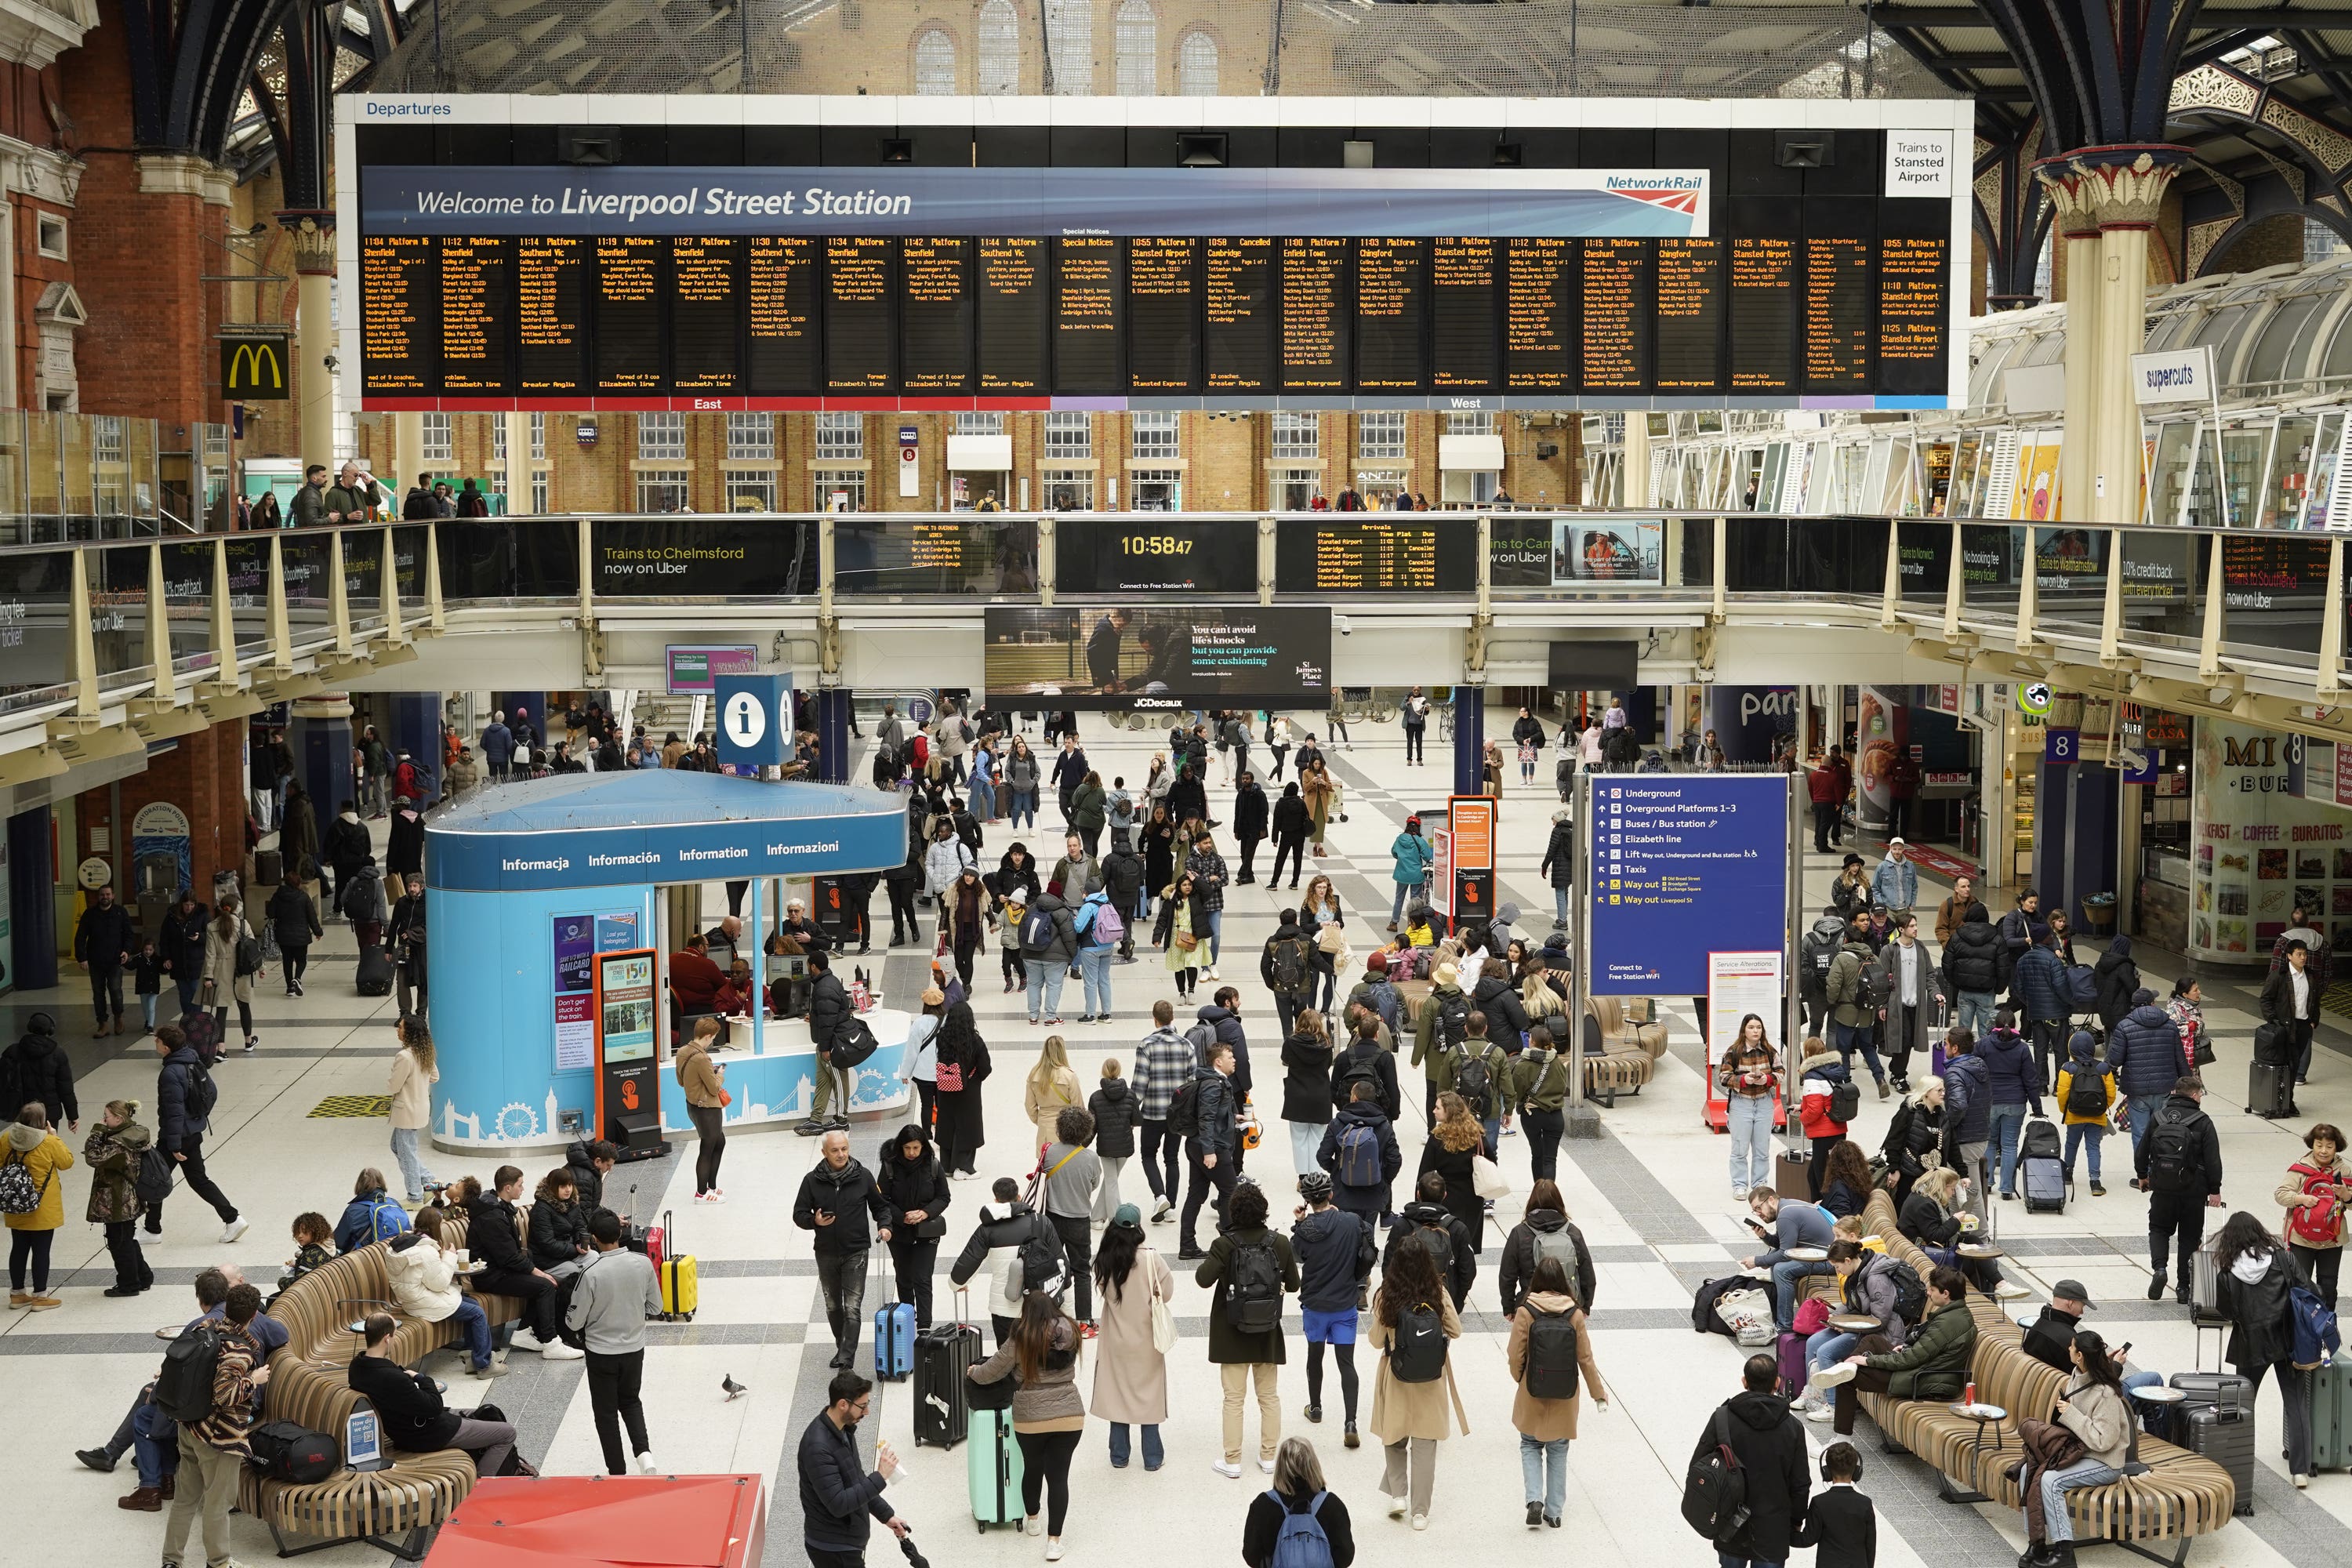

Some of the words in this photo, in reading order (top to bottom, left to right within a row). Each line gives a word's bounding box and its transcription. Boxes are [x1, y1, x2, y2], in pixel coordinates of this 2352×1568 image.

[367, 103, 451, 118] Departures
[1897, 142, 1928, 153] Trains
[1930, 143, 1942, 153] to
[1895, 157, 1944, 167] Stansted
[1898, 171, 1939, 184] Airport
[418, 192, 524, 213] Welcome
[532, 194, 554, 214] to
[561, 187, 698, 222] Liverpool
[704, 188, 795, 215] Street
[802, 188, 911, 215] Station
[1062, 238, 1086, 247] Special
[1165, 249, 1190, 258] Airport
[1207, 249, 1241, 258] Cambridge
[2147, 364, 2193, 393] supercuts
[695, 399, 721, 409] East
[1451, 398, 1480, 411] West
[604, 548, 644, 559] Trains
[646, 548, 661, 559] to
[663, 547, 744, 559] Chelmsford
[605, 565, 633, 574] now
[636, 564, 653, 574] on
[656, 562, 688, 574] Uber
[2038, 555, 2053, 569] Trains
[2053, 557, 2059, 570] to
[2060, 557, 2097, 572] Walthamstow
[2123, 561, 2136, 576] 10%
[2136, 563, 2156, 578] credit
[2156, 563, 2172, 579] back
[1210, 625, 1231, 633] can't
[1232, 625, 1256, 633] avoid
[1192, 635, 1212, 644] life's
[1243, 646, 1277, 656] provide
[1218, 657, 1267, 666] cushioning
[1134, 698, 1182, 707] JCDecaux
[2147, 728, 2186, 739] CASA
[2056, 736, 2069, 756] 8
[1626, 789, 1681, 799] Underground
[1626, 804, 1675, 814] Overground
[136, 805, 172, 829] REHYDRATION
[172, 811, 187, 828] POINT
[2243, 826, 2279, 841] COFFEE
[2292, 824, 2343, 842] BURRITOS
[768, 840, 838, 855] Informazioni
[589, 851, 660, 866] Información
[680, 847, 748, 861] Information
[503, 857, 569, 870] Informacja
[1624, 880, 1642, 890] Way
[1624, 896, 1642, 905] Way
[559, 958, 590, 973] RAILCARD
[1044, 1273, 1062, 1294] NIKE
